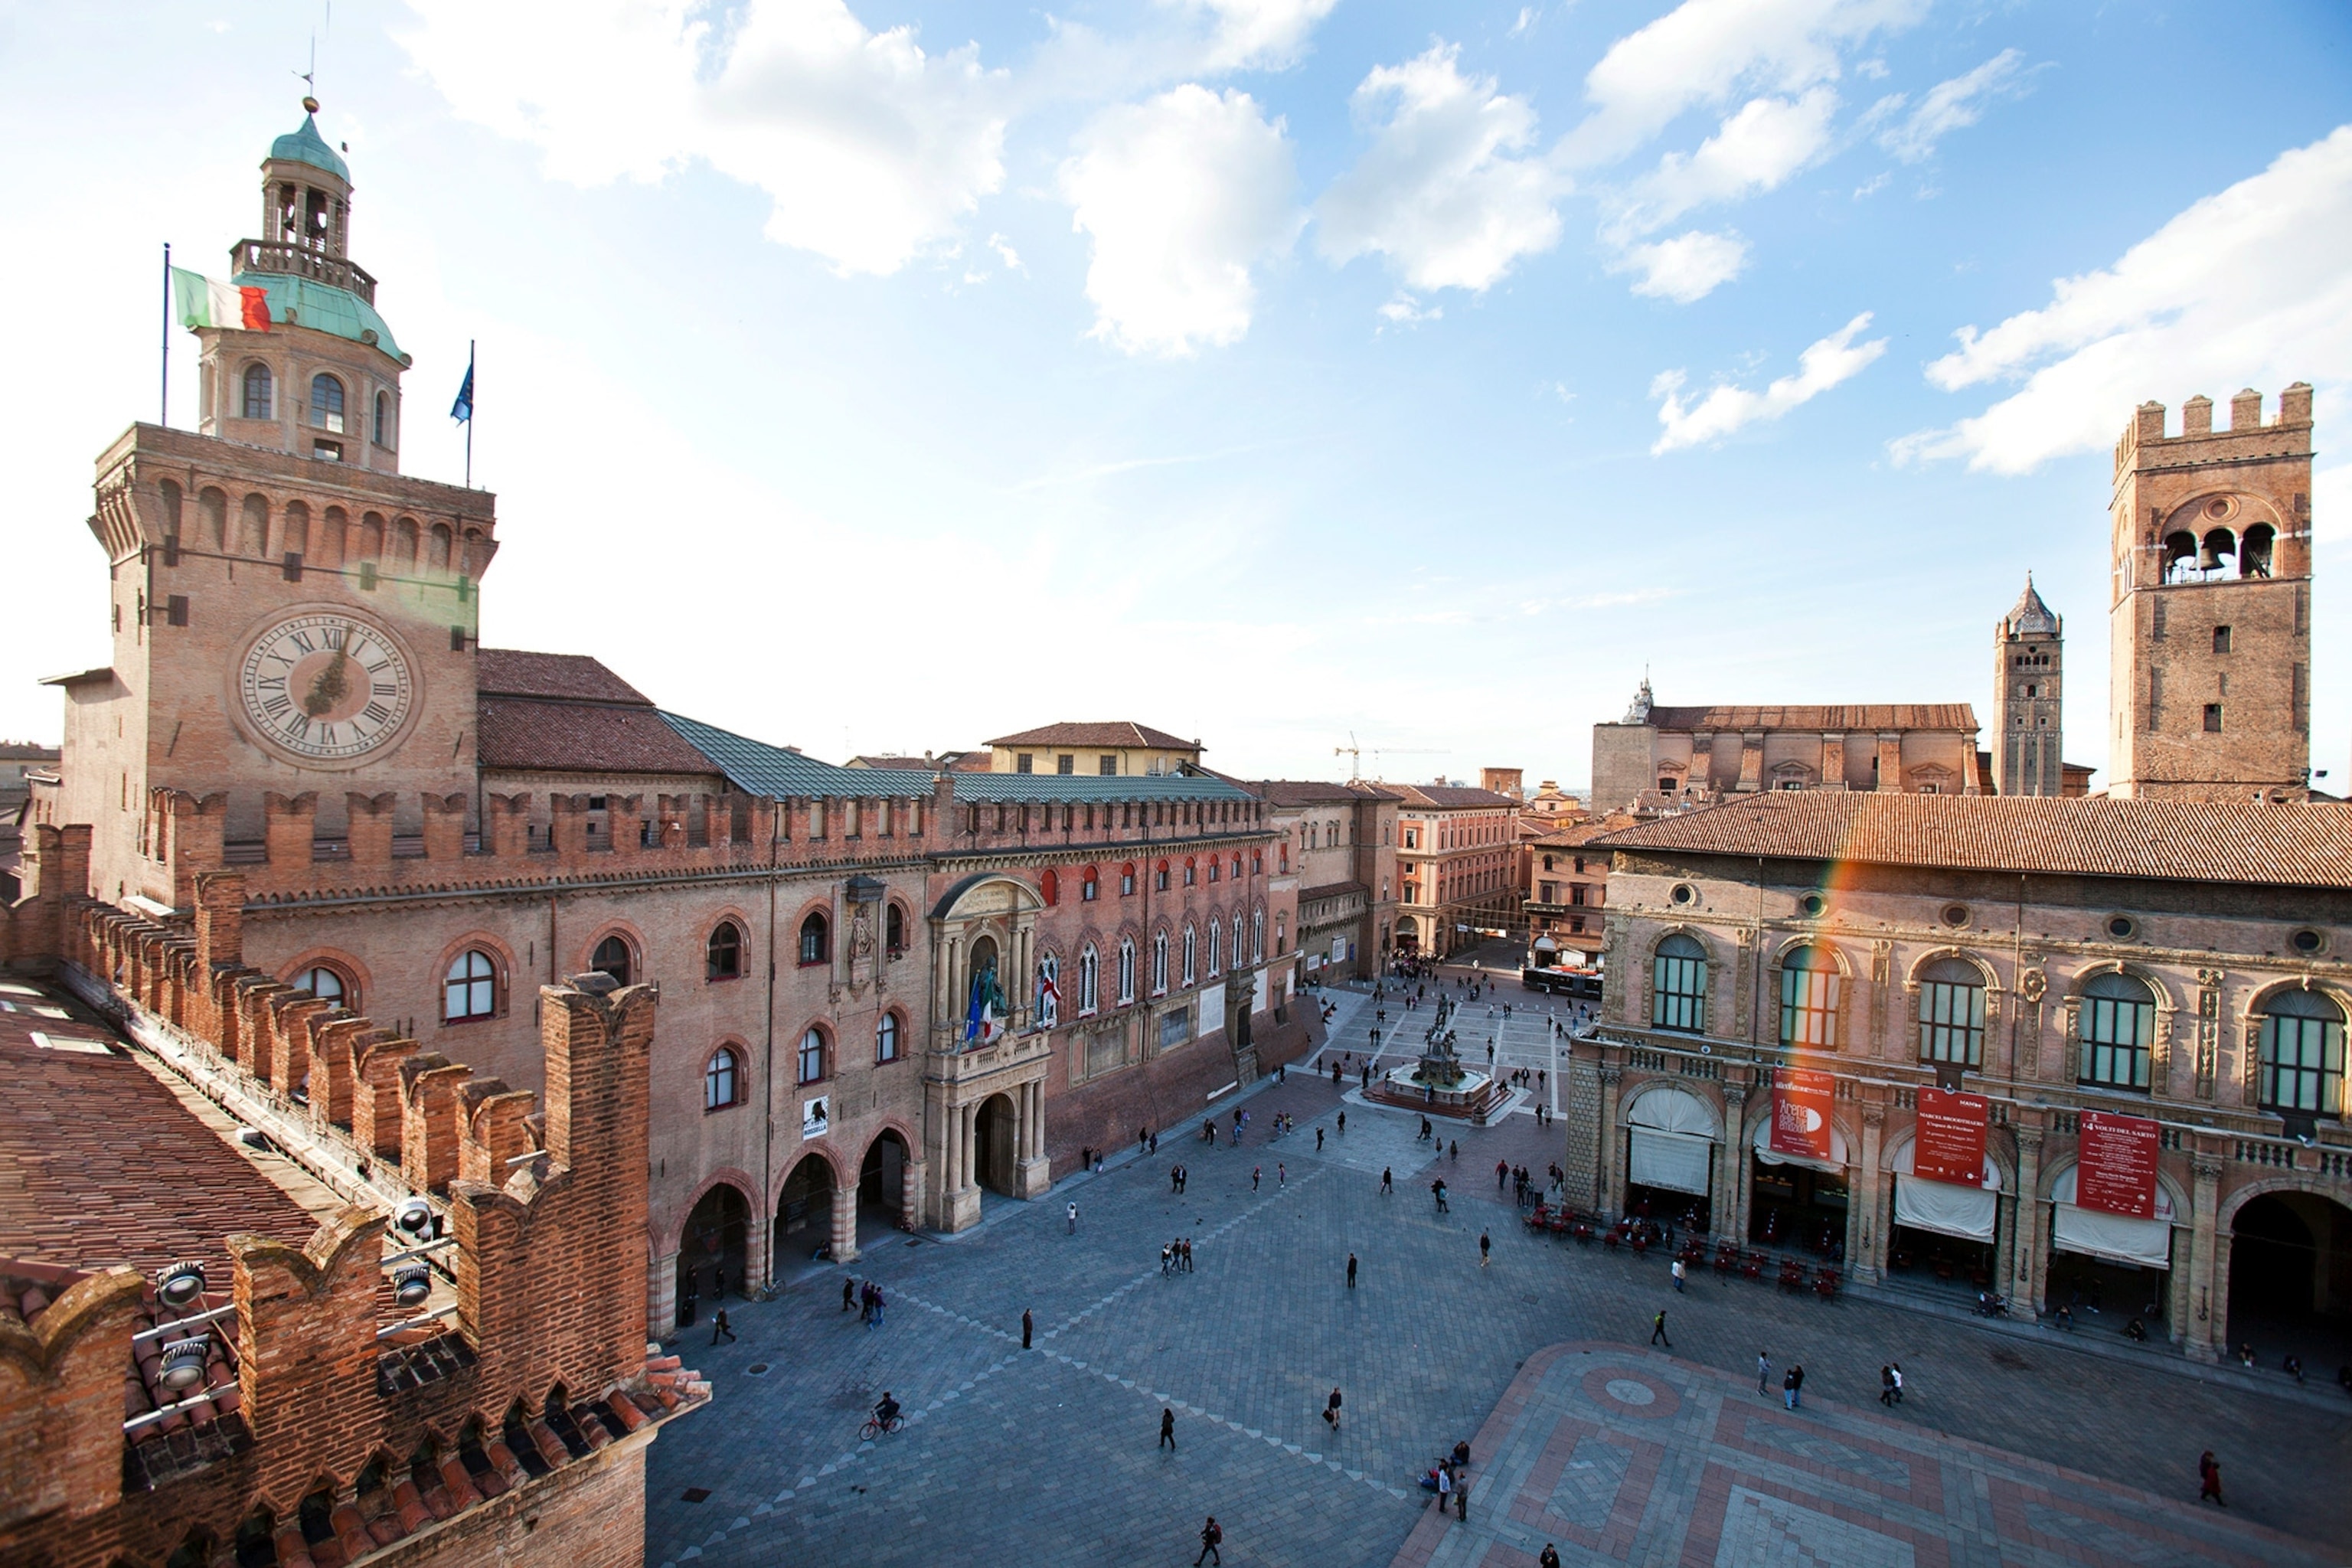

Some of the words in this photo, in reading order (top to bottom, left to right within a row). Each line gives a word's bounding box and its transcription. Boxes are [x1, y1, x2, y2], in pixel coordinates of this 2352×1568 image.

[1919, 1112, 1942, 1120] MARCEL
[804, 1124, 826, 1135] ROSSELLA
[2087, 1122, 2094, 1131] 4
[2132, 1130, 2156, 1138] SARTO
